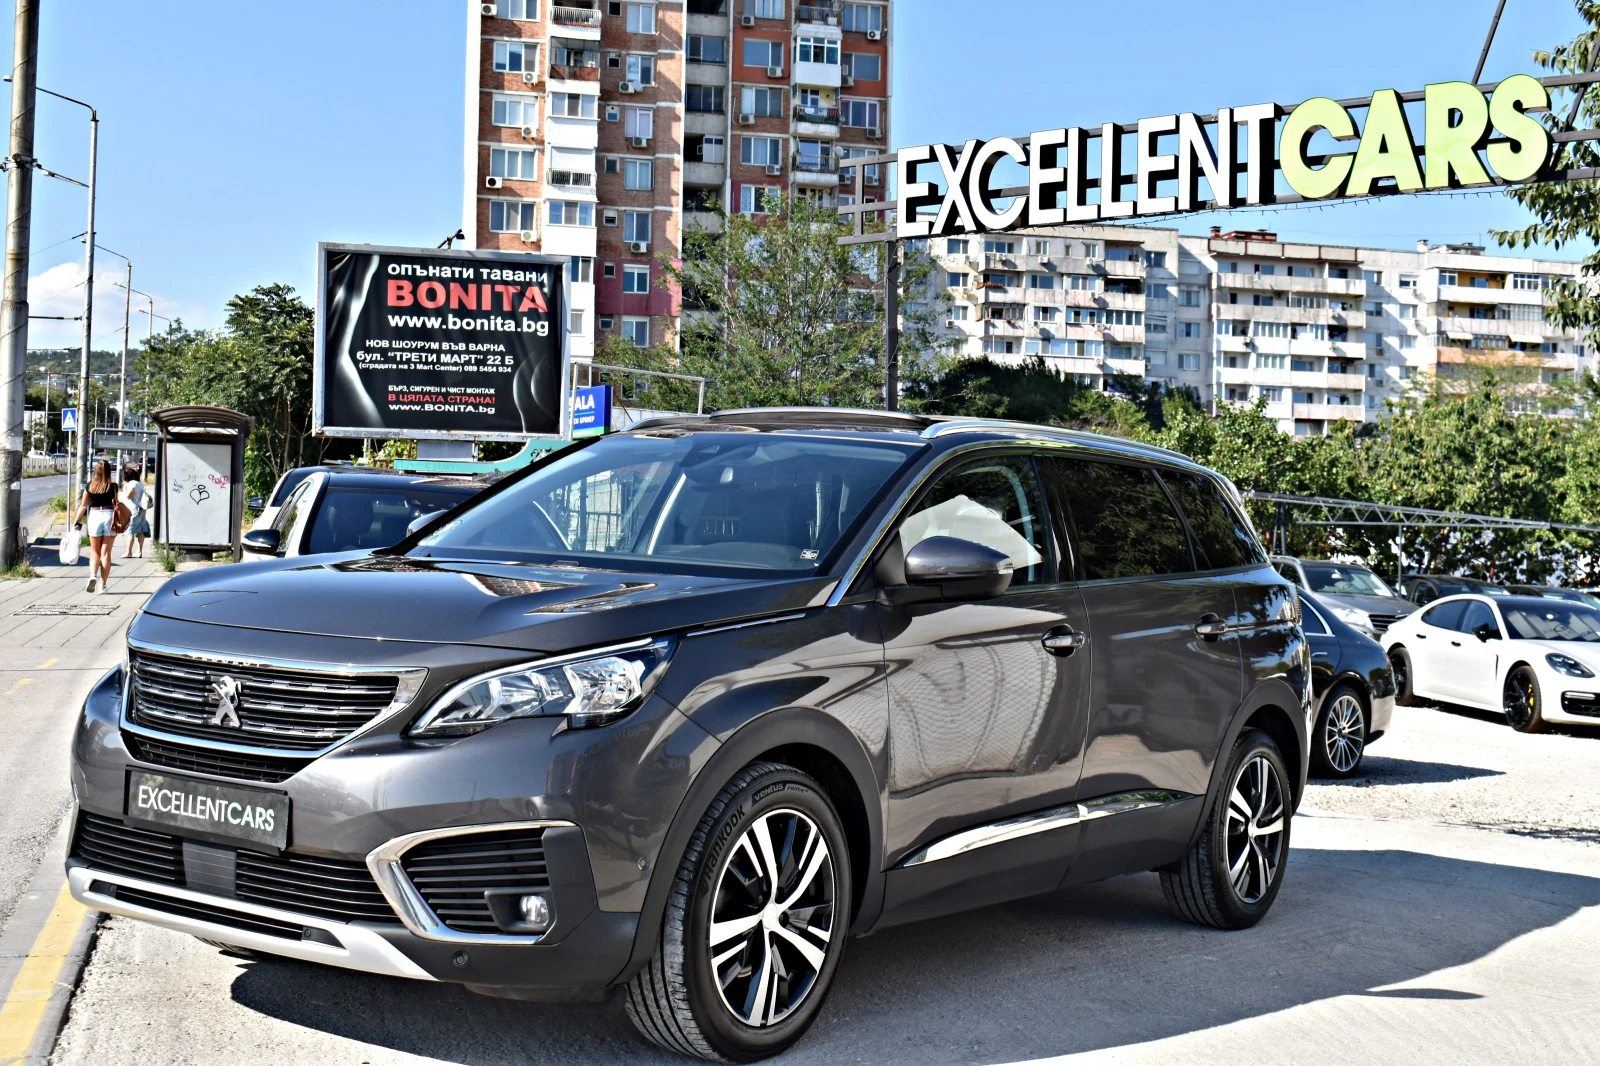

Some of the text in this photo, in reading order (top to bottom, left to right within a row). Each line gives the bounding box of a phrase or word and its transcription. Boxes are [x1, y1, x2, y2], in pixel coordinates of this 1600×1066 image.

[387, 263, 548, 284] опънати тавани
[387, 279, 548, 313] BONITA
[387, 314, 549, 337] www.bonita.bg
[366, 339, 506, 352] НОВ ШОУРУМ ВЪВ ВАРНА
[356, 351, 384, 363] бул.
[487, 355, 502, 365] 22
[504, 355, 514, 365] Б
[435, 364, 462, 372] Center)
[388, 385, 409, 394] БЪРЗ,
[410, 385, 440, 393] СИГУРЕН
[466, 387, 495, 395] МОНТАЖ
[388, 393, 495, 404] В ЦЯЛАТА СТРАНА!
[389, 403, 496, 414] www.BONITA.bg
[138, 785, 275, 832] EXCELLENTCARS
